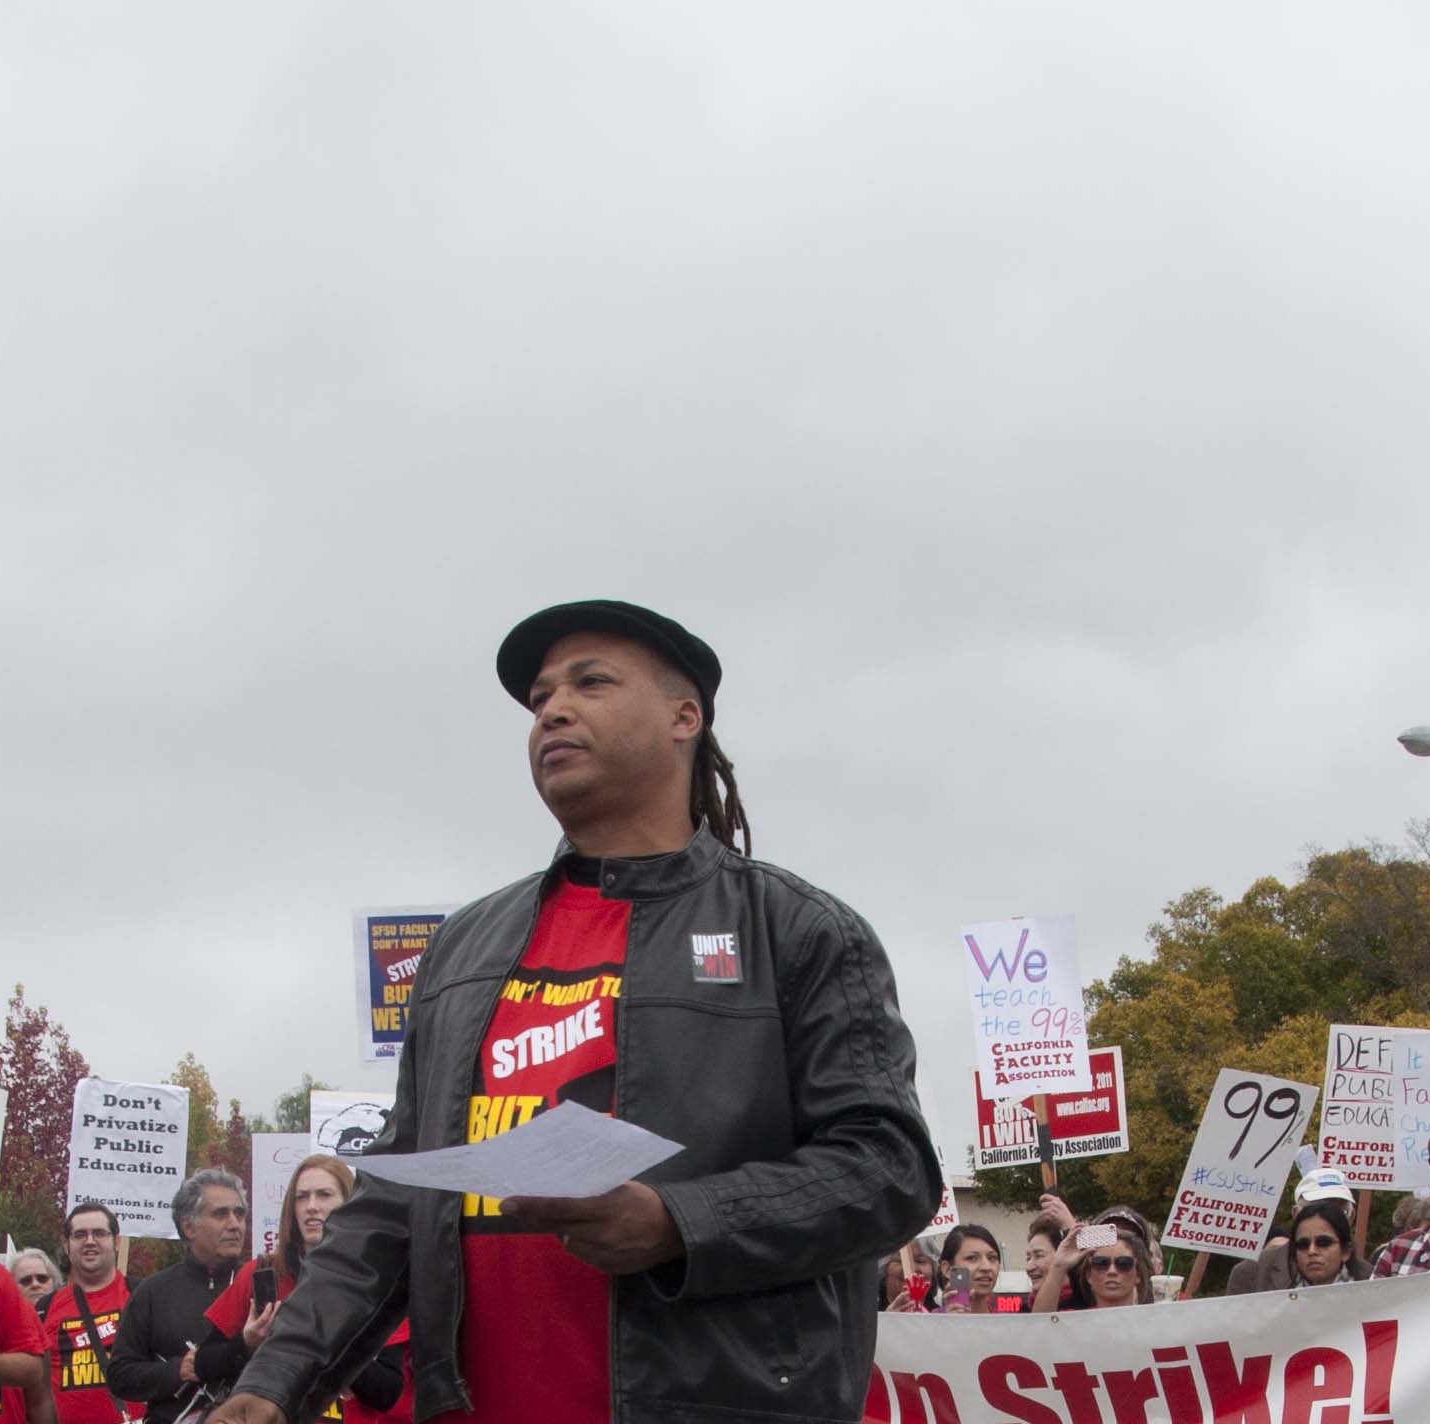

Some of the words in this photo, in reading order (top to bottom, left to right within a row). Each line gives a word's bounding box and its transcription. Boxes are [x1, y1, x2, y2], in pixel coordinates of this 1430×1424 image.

[372, 925, 396, 936] SFSU
[373, 939, 399, 950] DON'T
[402, 938, 428, 949] WANT
[692, 934, 736, 955] UNITE
[964, 929, 1048, 983] We
[387, 954, 422, 983] STRI
[543, 977, 598, 1006] WANT
[975, 986, 1057, 1009] teach
[373, 1007, 401, 1031] WE
[981, 1016, 1020, 1037] the
[1031, 1007, 1082, 1038] 99%
[492, 1000, 604, 1079] STRIKE
[991, 1040, 1074, 1056] CALIFORNIA
[994, 1053, 1074, 1070] FACULTY
[1336, 1032, 1393, 1070] DEF
[1407, 1049, 1420, 1069] It
[995, 1069, 1075, 1085] ASSOCIATION
[1332, 1073, 1393, 1100] PUBL
[103, 1094, 161, 1111] Don't
[83, 1114, 178, 1133] Privatize
[467, 1095, 544, 1144] BUT
[1325, 1106, 1391, 1127] EDUCA
[94, 1137, 163, 1154] Public
[981, 1145, 1027, 1165] California
[1029, 1140, 1063, 1160] Falty
[1065, 1135, 1122, 1153] Association
[1323, 1136, 1394, 1151] CALIFOR
[78, 1157, 177, 1175] Education
[75, 1194, 141, 1207] Education
[144, 1199, 155, 1208] is
[157, 1199, 173, 1209] fo
[1179, 1190, 1268, 1219] CALIFORNIA
[1173, 1206, 1264, 1234] FACULTY
[1167, 1223, 1258, 1250] ASSOCIATION
[63, 1367, 68, 1387] I
